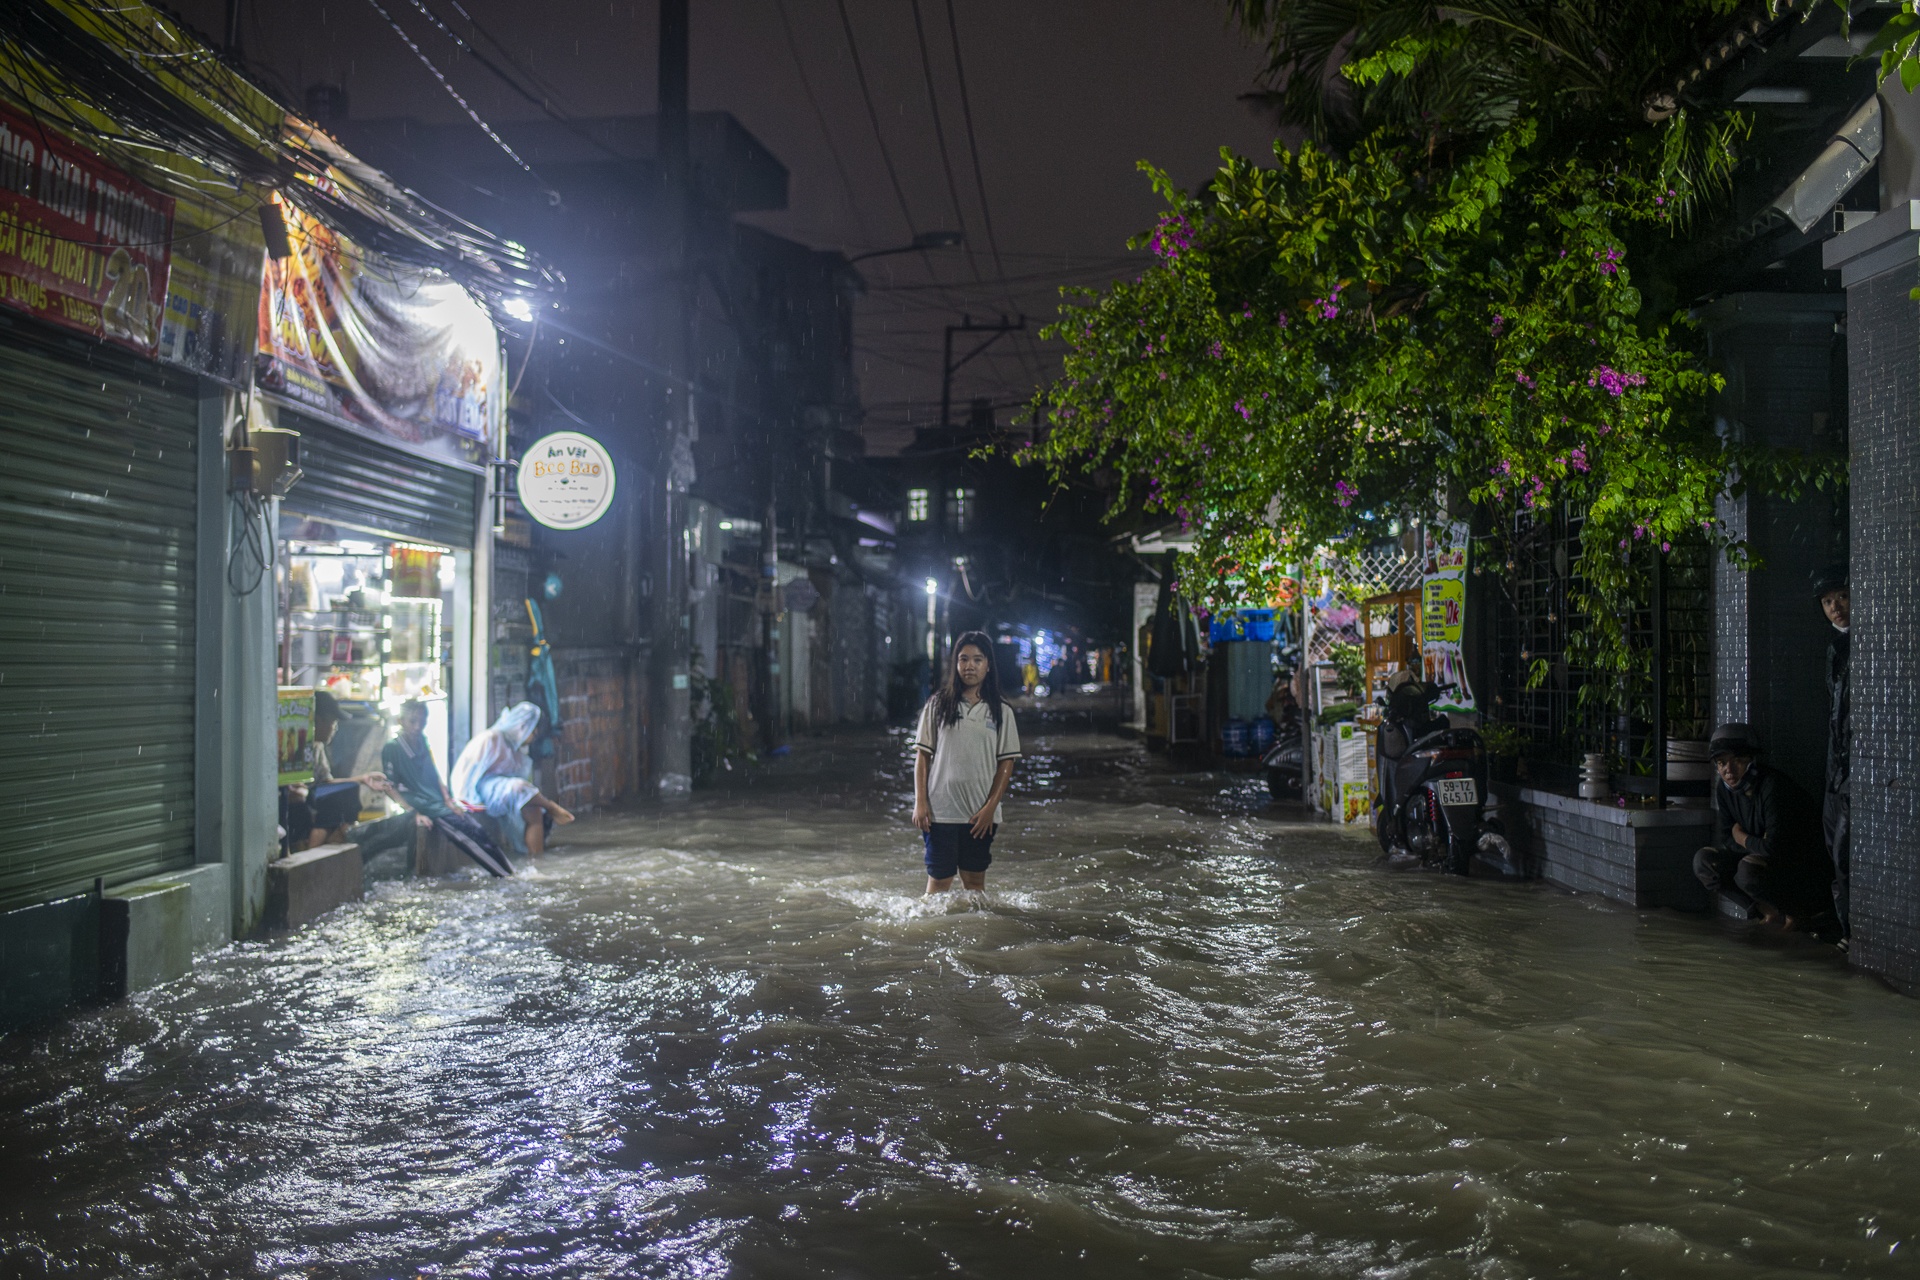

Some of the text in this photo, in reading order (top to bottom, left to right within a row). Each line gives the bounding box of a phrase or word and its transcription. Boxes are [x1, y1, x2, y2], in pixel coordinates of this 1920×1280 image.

[38, 149, 91, 226] KHAI
[20, 218, 51, 269] CÁC
[52, 239, 86, 285] DỊCH
[10, 276, 49, 311] 04/05
[1442, 792, 1474, 804] 645.17
[1443, 781, 1471, 792] 59-T2
